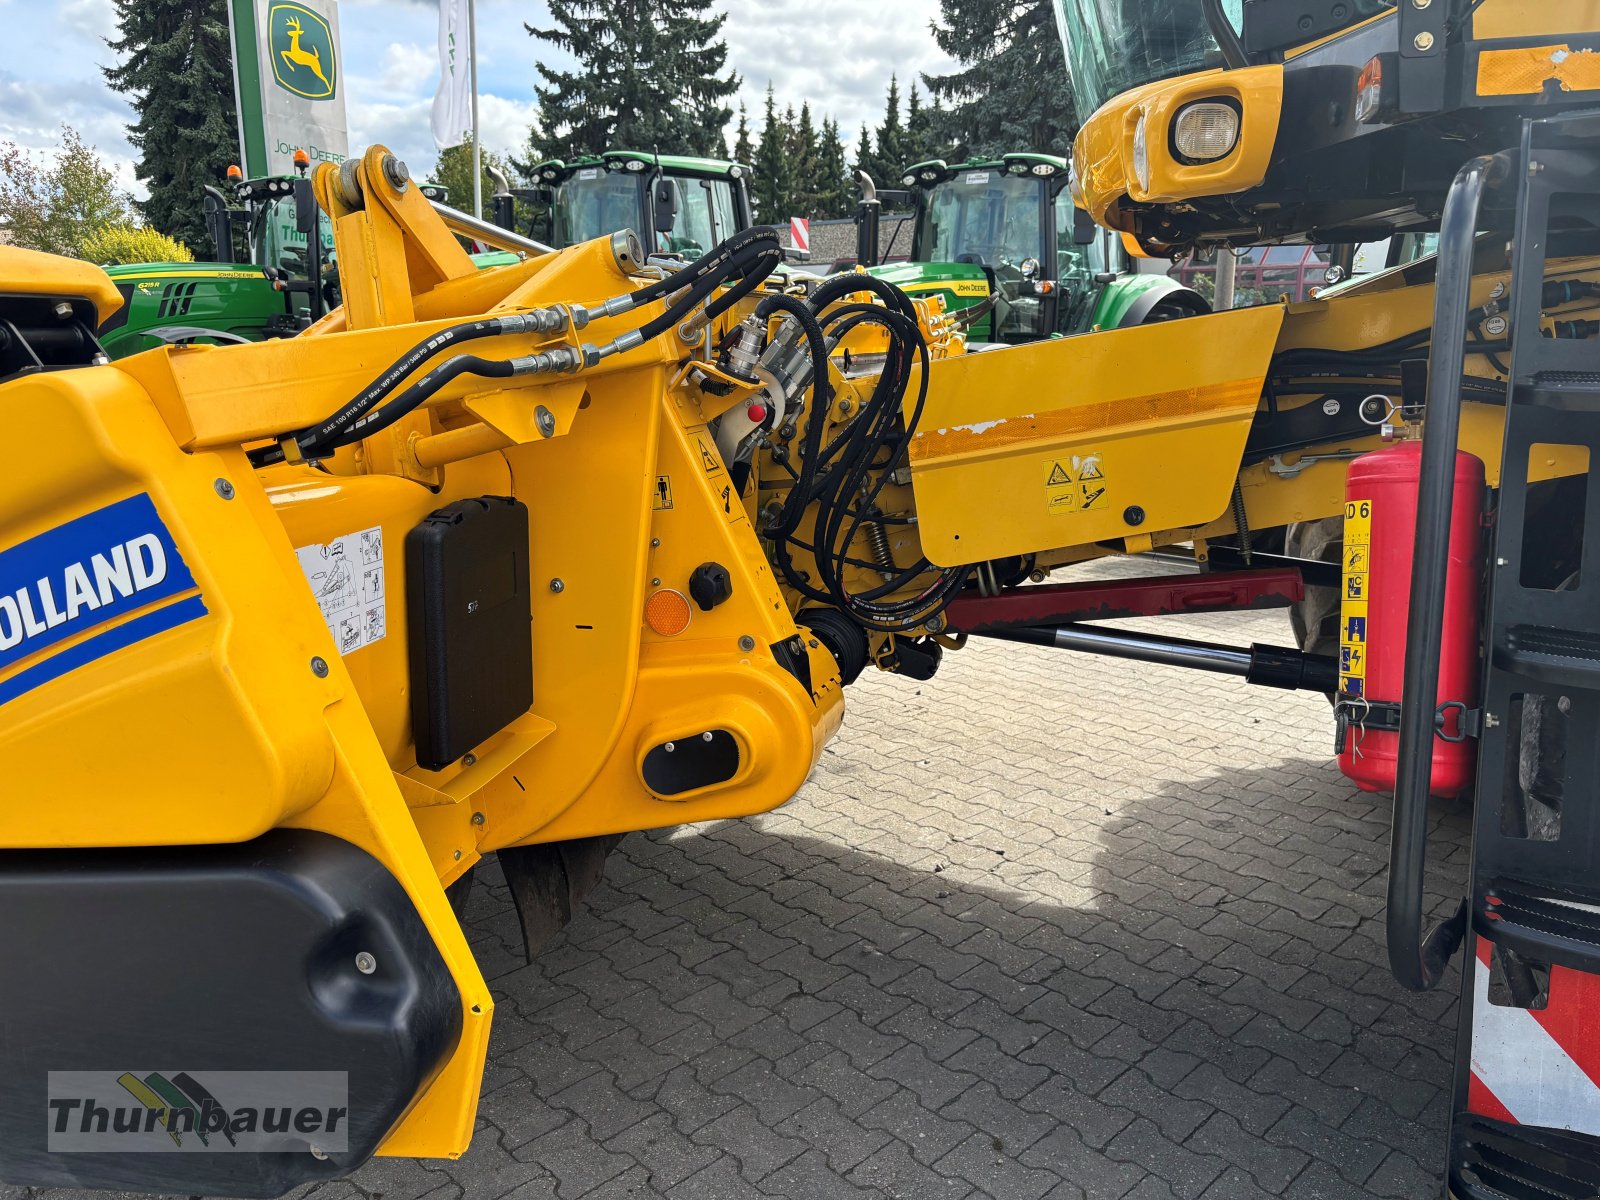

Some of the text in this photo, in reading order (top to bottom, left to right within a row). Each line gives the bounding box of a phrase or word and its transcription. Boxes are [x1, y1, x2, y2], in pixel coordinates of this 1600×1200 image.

[274, 139, 303, 156] JOH
[957, 284, 987, 292] JOHN DEERE
[322, 422, 337, 434] SAE
[335, 415, 347, 425] 100
[1360, 502, 1370, 519] 6
